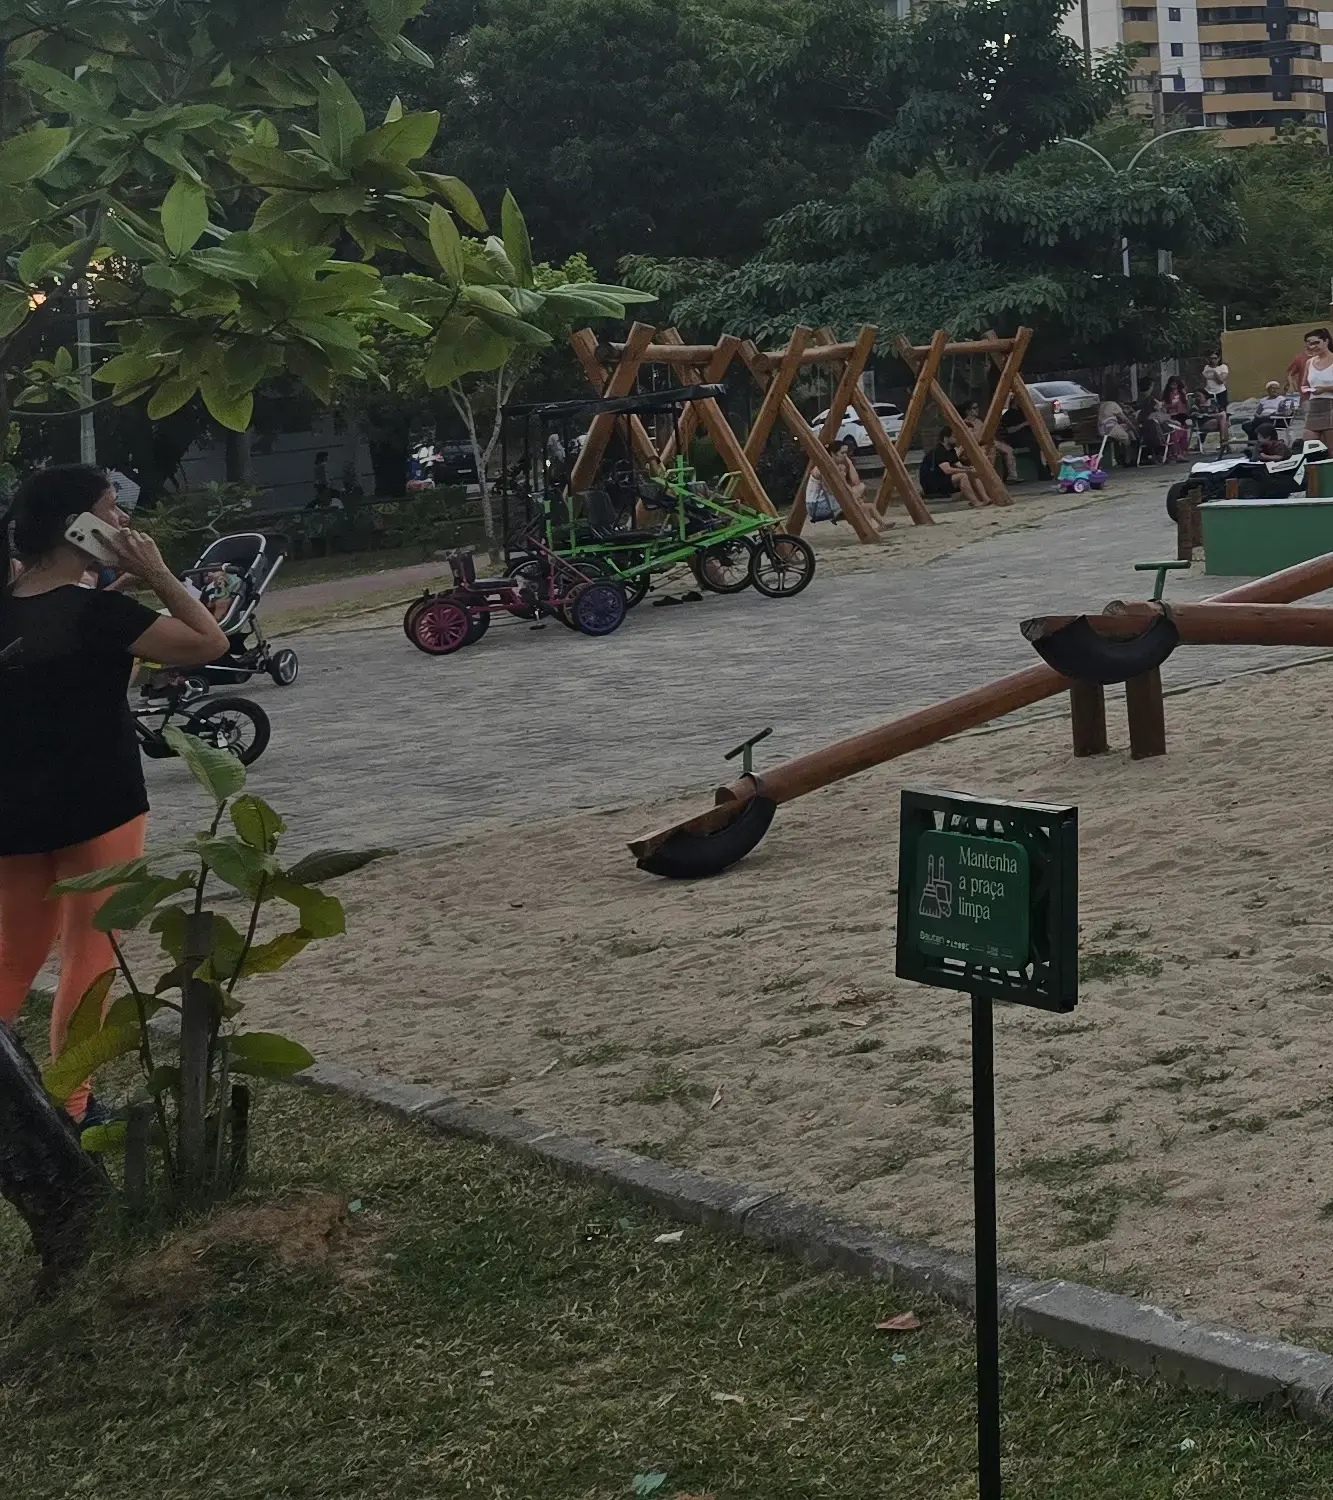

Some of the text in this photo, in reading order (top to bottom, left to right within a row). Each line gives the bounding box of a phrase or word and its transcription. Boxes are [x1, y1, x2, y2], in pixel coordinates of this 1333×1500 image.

[959, 845, 1018, 874] Mantenha
[958, 875, 1005, 900] a praça
[958, 896, 991, 923] limpa
